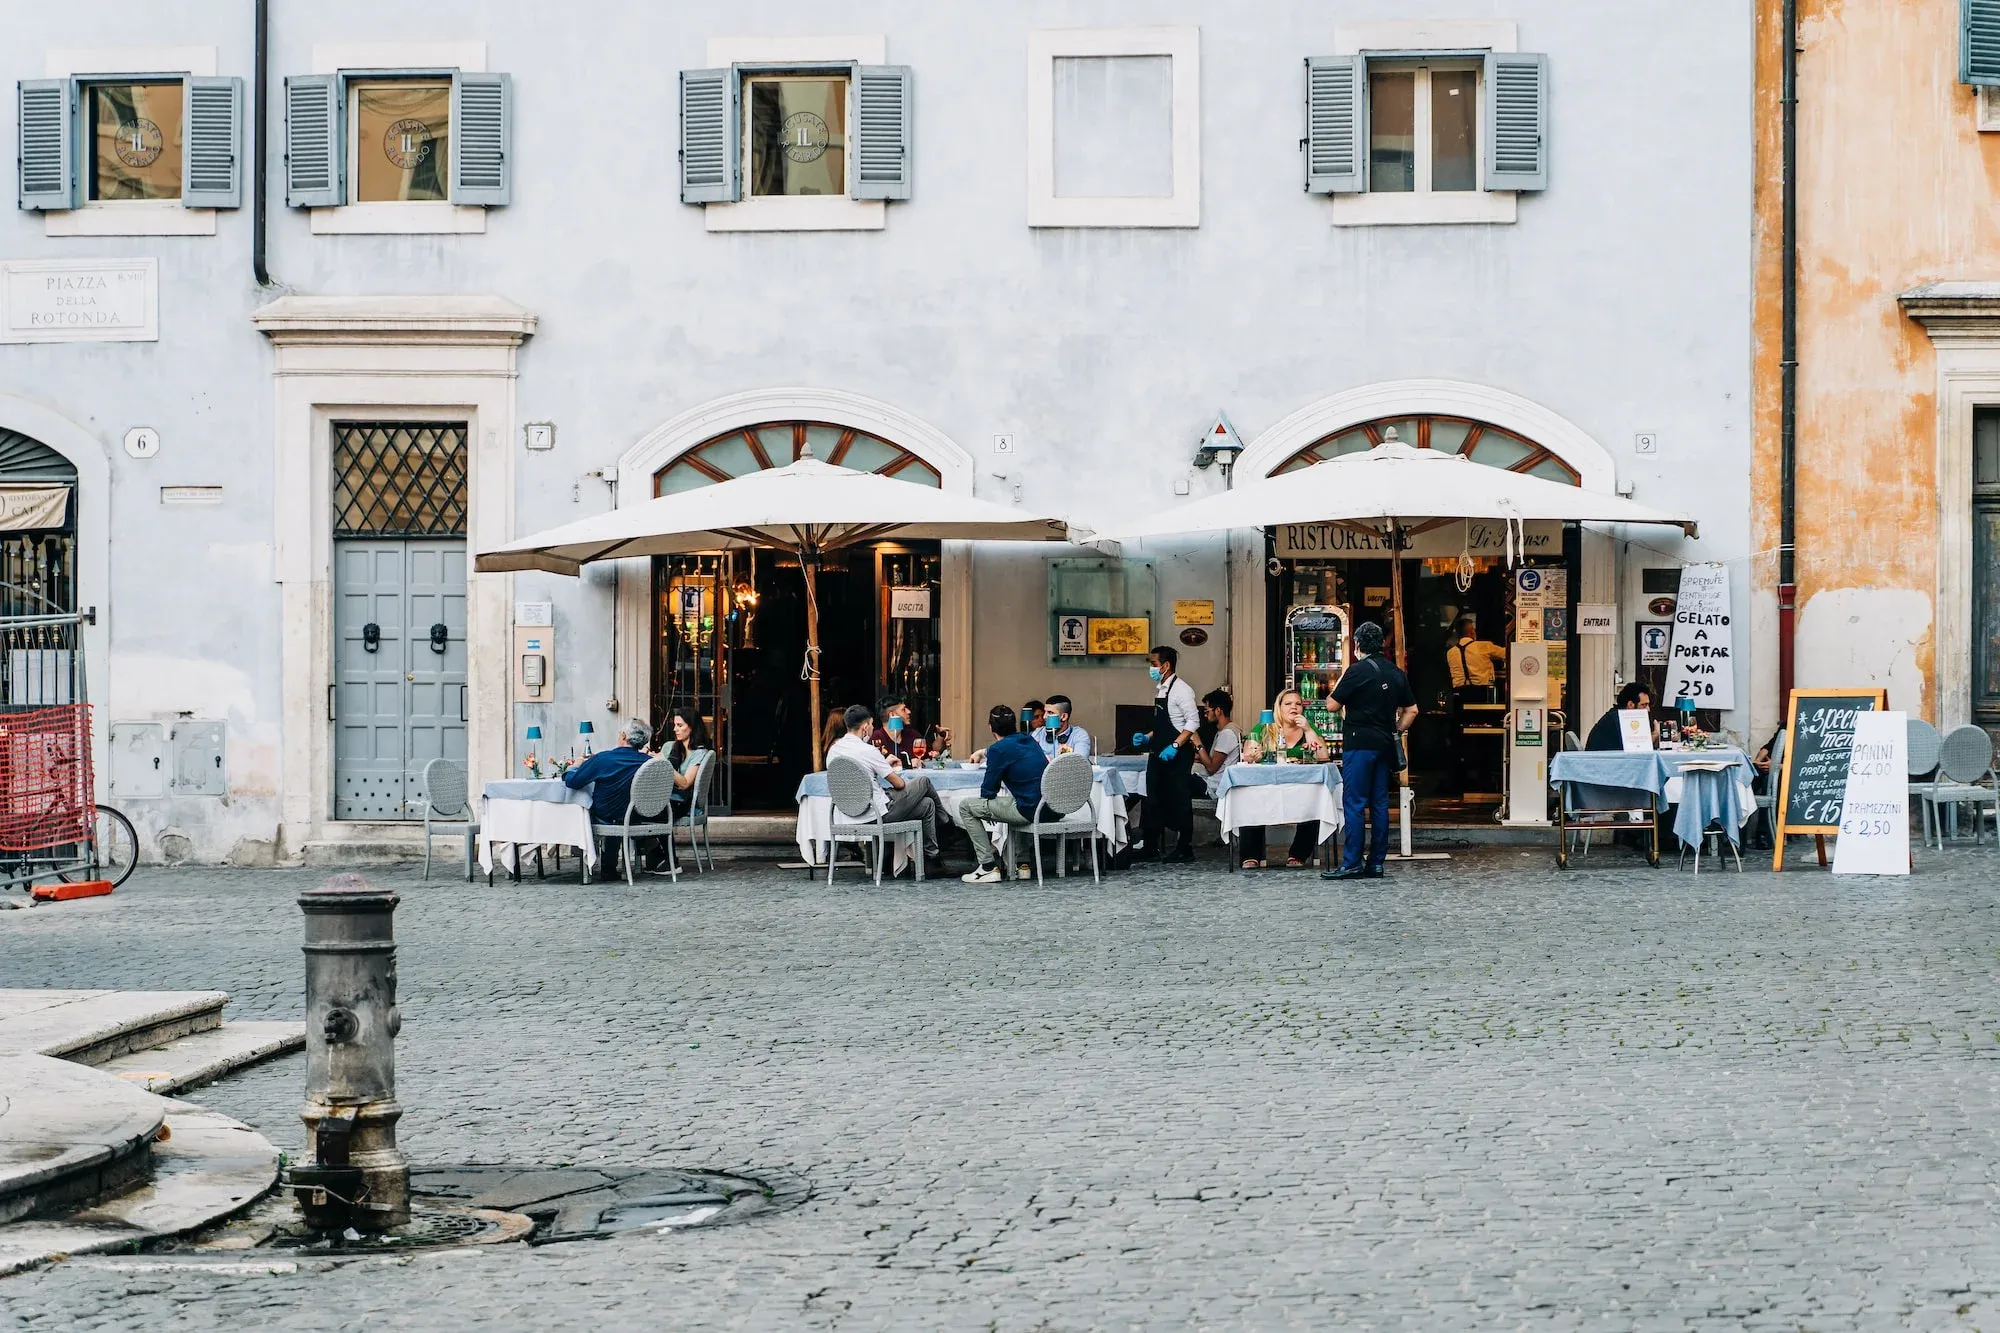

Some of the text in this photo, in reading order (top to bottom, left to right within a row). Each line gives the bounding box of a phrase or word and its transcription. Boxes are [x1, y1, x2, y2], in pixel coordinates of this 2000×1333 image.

[132, 133, 147, 152] IL
[401, 134, 417, 153] IL
[797, 127, 813, 146] IL
[47, 276, 107, 290] PIAZZA
[56, 296, 97, 306] DELLA
[31, 311, 121, 325] ROTONDA
[137, 434, 146, 450] 6
[536, 431, 543, 442] 7
[1641, 437, 1650, 450] 9
[999, 438, 1007, 450] 8
[1287, 524, 1414, 551] RISTORANE
[897, 603, 924, 612] USCITA
[1583, 617, 1610, 627] ENTRATA
[1676, 611, 1730, 626] GELATO
[1694, 629, 1708, 640] A
[1674, 644, 1730, 658] PORTAR
[1820, 733, 1854, 748] men
[1799, 764, 1827, 777] PASTA
